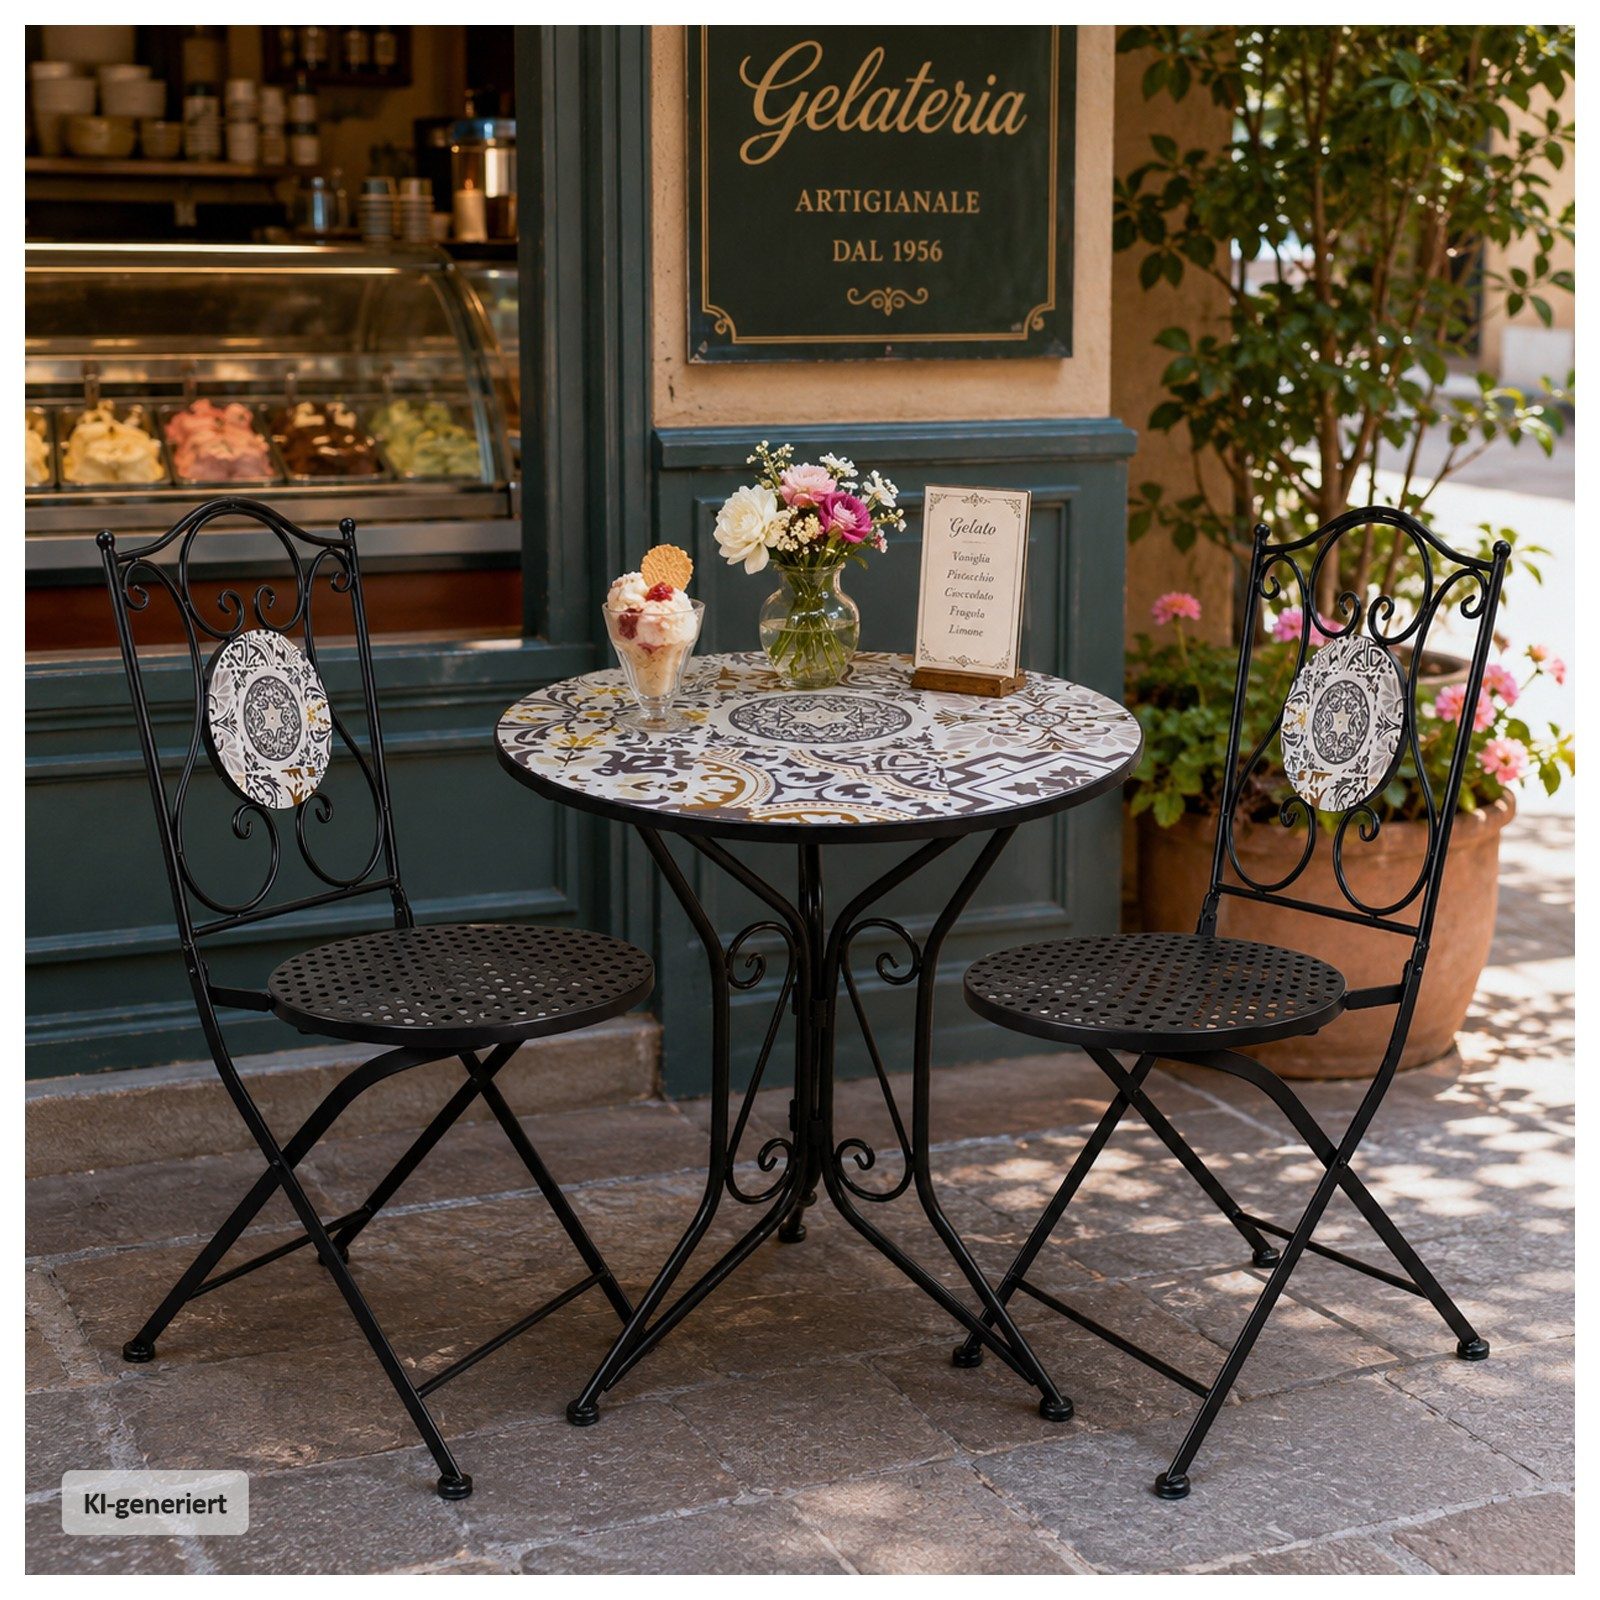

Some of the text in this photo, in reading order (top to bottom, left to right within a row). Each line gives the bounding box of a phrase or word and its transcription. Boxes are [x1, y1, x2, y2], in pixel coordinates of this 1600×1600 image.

[738, 40, 1028, 166] Gelateria
[795, 188, 981, 214] ARTIGIANALE
[832, 239, 943, 263] DAL 1956
[949, 516, 997, 538] Gelato
[948, 624, 984, 637] Limone
